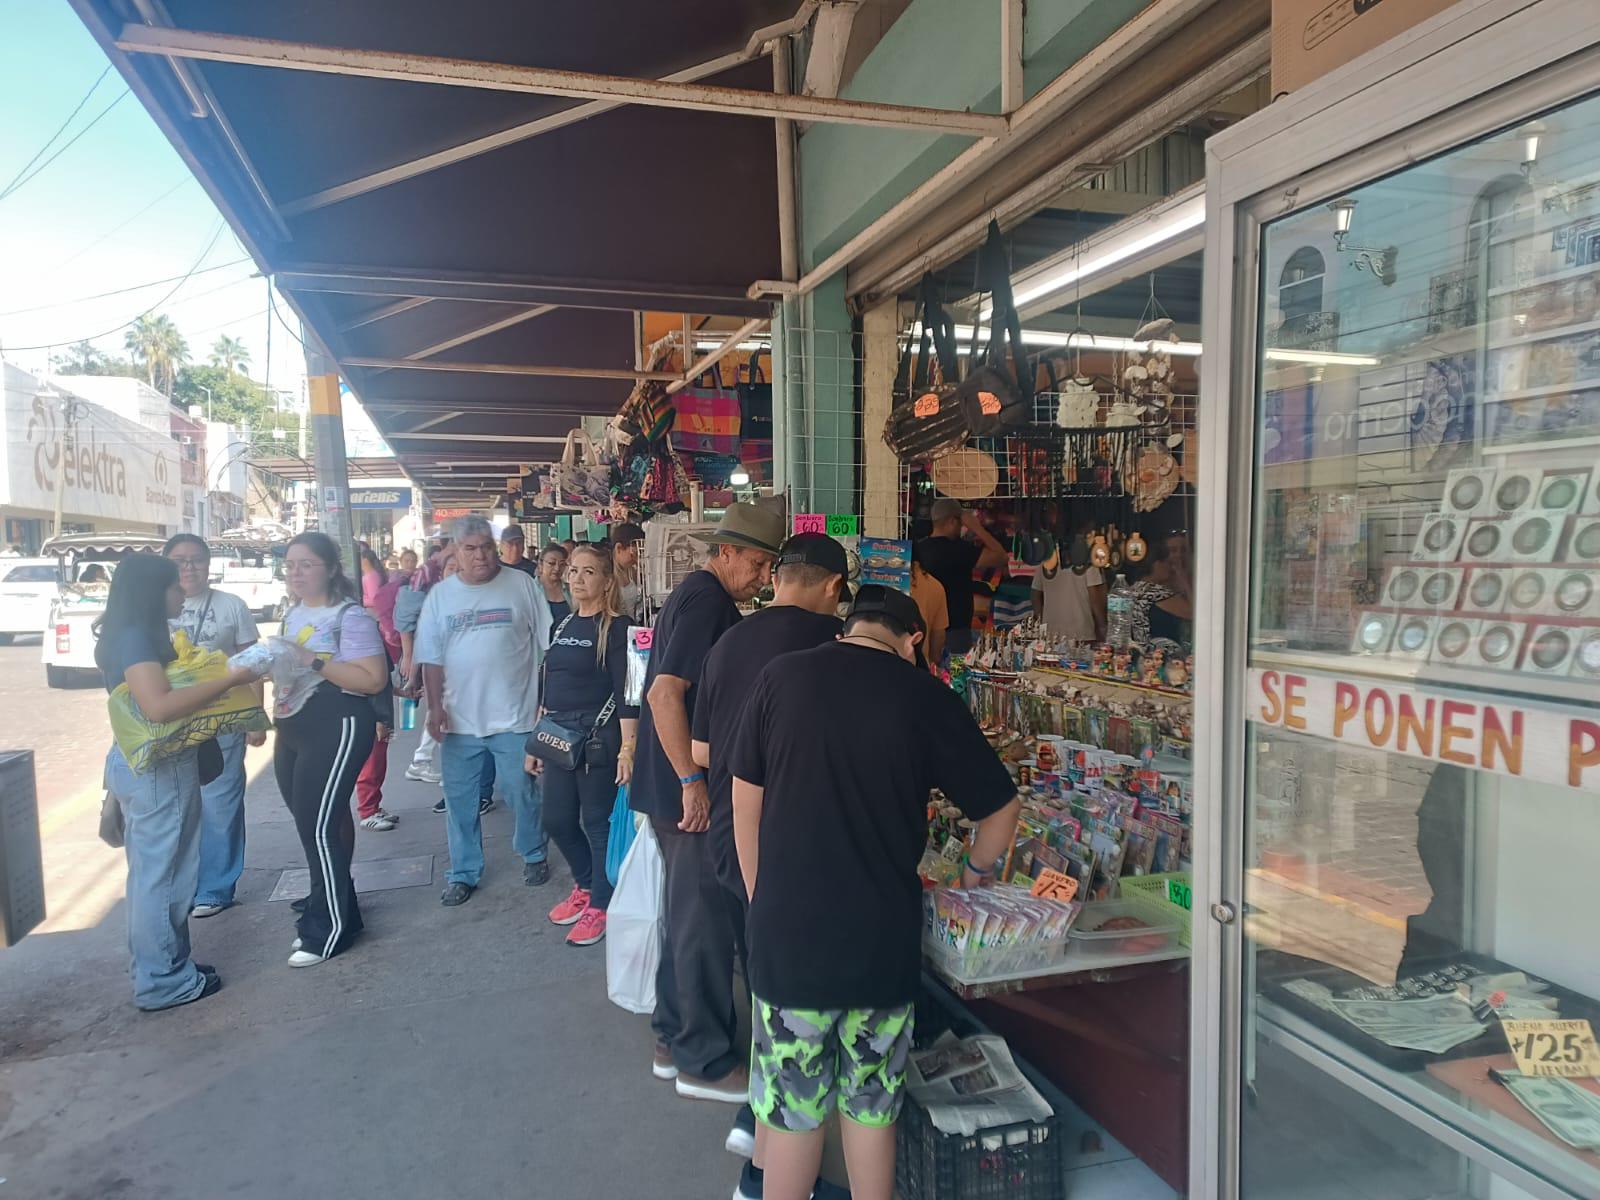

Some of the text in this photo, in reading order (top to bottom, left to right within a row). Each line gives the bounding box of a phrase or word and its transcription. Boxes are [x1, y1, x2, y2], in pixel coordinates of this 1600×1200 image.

[64, 421, 127, 497] elektra
[832, 522, 849, 535] 60
[537, 731, 572, 752] GUESS
[1261, 670, 1307, 730] SE
[1333, 680, 1524, 776] PONEN
